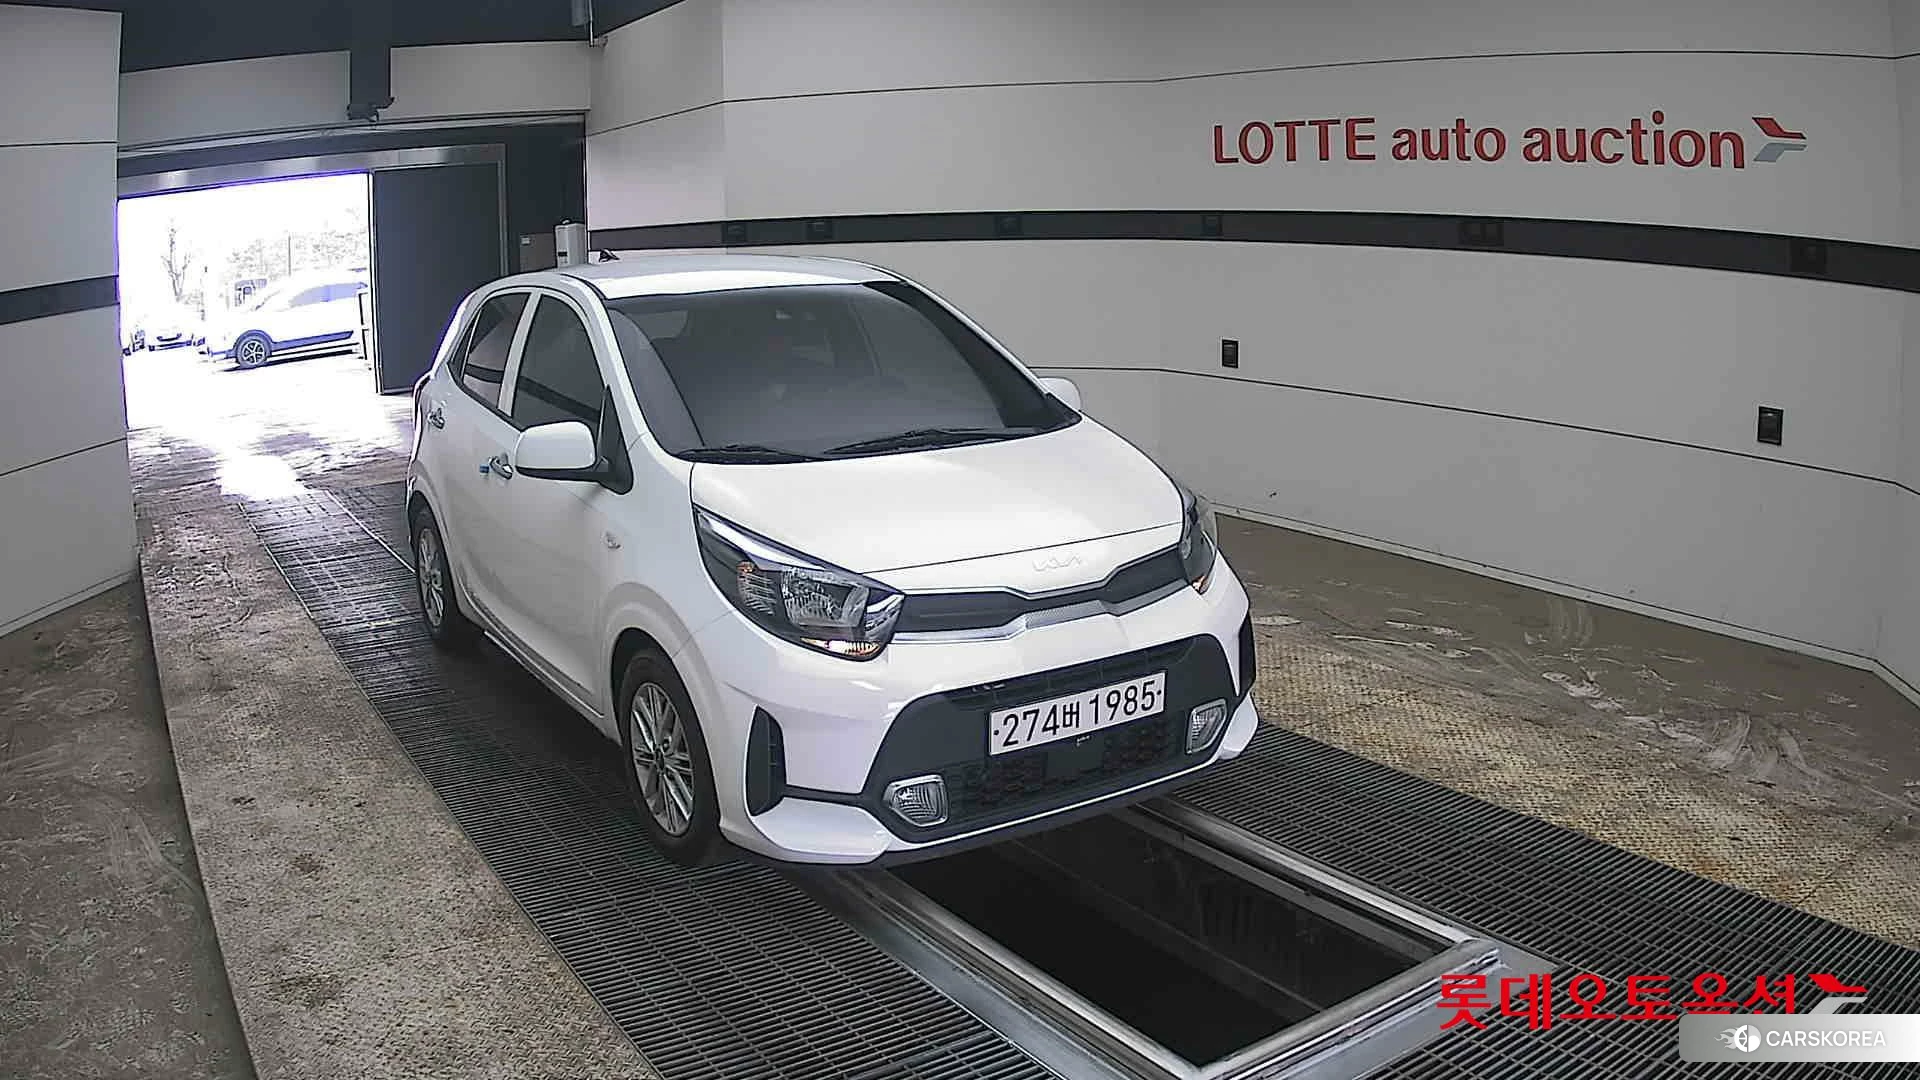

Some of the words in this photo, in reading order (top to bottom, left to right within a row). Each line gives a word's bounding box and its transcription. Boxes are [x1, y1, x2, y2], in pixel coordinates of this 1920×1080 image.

[1213, 117, 1377, 164] LOTTE
[1391, 118, 1507, 162] auto
[1522, 110, 1746, 169] auction
[1002, 701, 1080, 748] 274버
[1088, 680, 1156, 725] 1985
